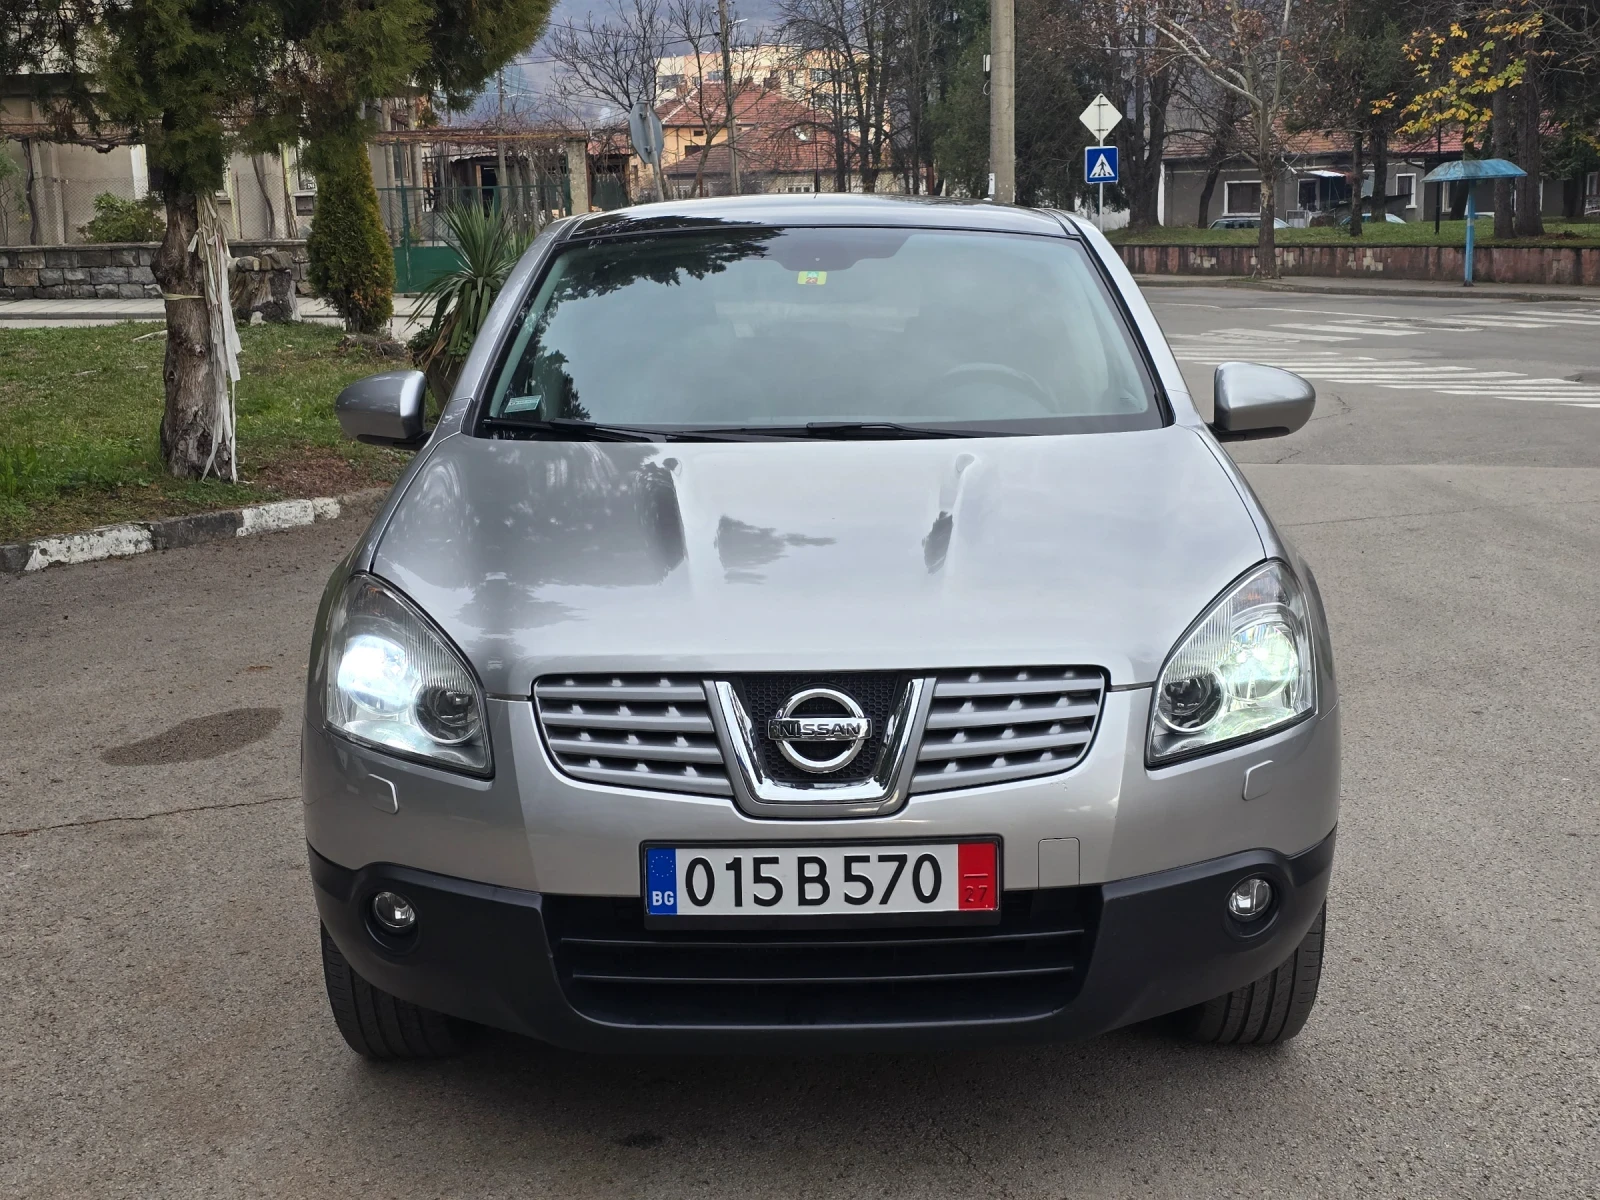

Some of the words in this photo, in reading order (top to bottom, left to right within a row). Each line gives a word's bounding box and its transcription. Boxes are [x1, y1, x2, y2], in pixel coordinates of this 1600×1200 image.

[779, 722, 861, 737] NISSAN
[652, 890, 674, 906] BG
[964, 884, 988, 903] 27
